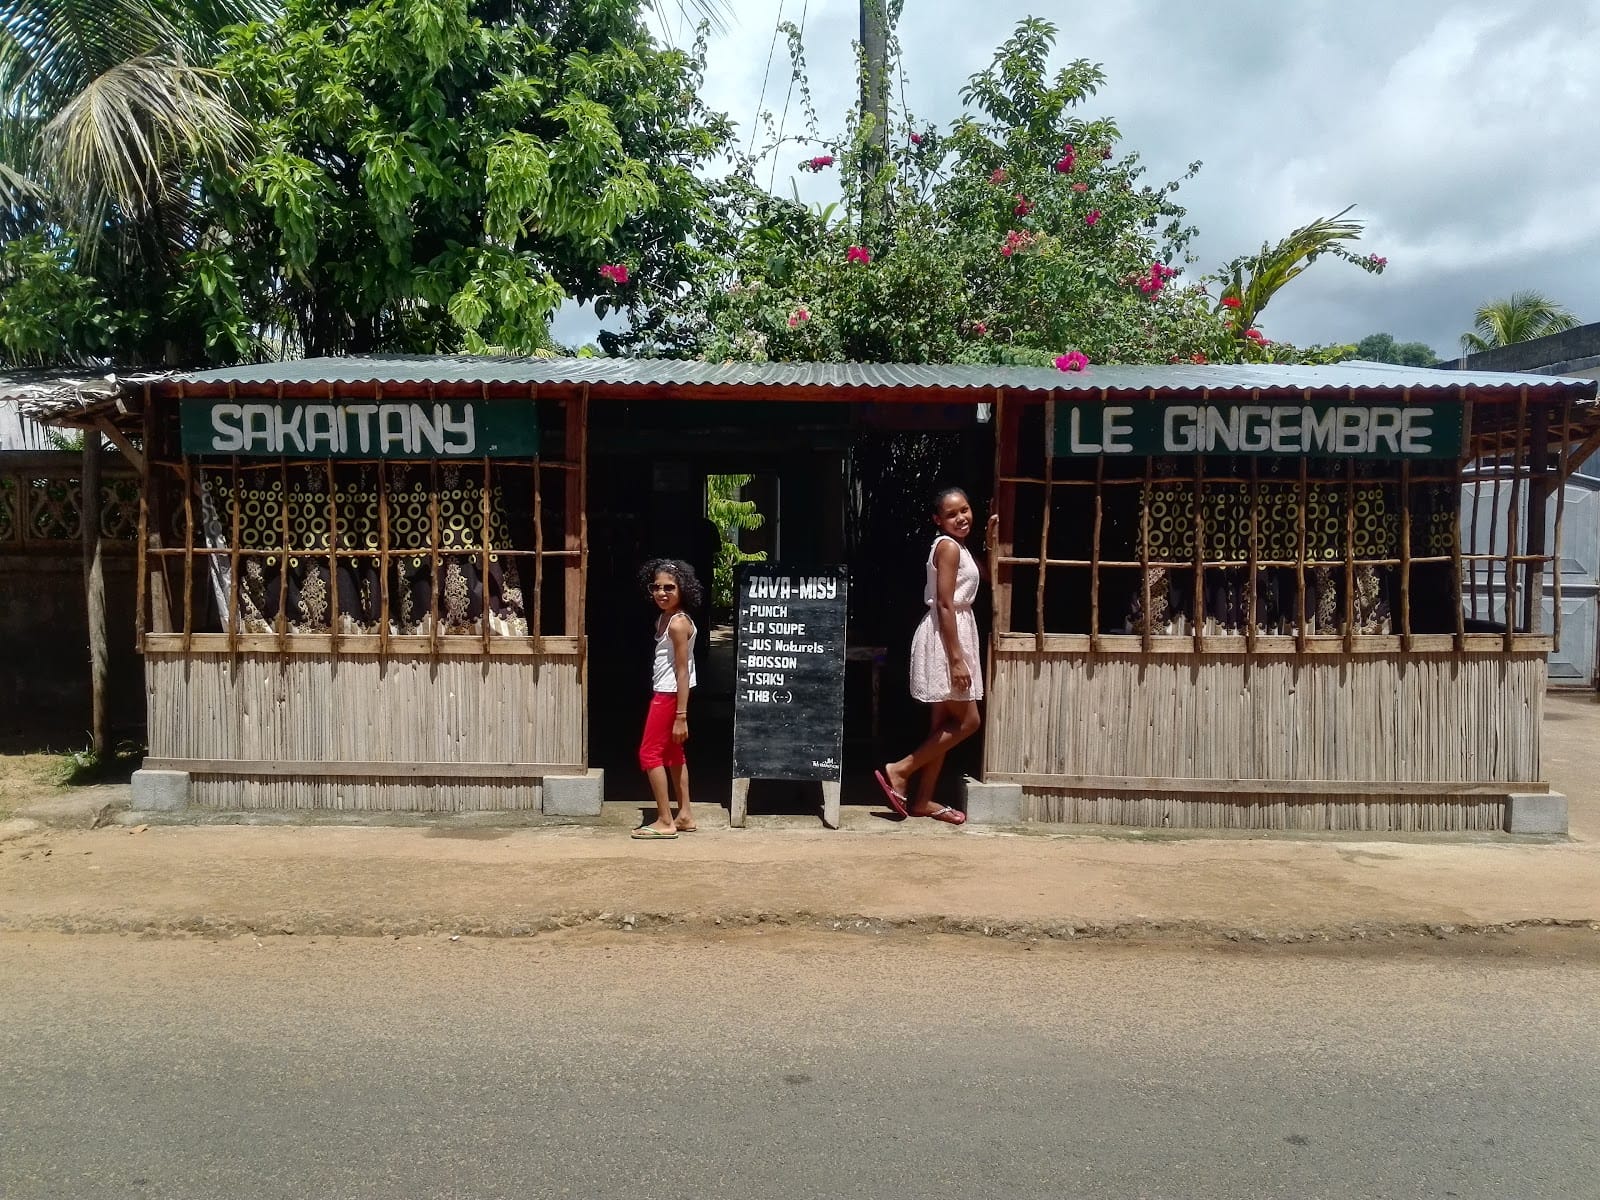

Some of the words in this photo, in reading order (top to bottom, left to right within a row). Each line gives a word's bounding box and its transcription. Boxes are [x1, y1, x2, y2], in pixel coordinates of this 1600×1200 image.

[211, 403, 475, 454] SAKAITANY
[1071, 406, 1134, 453] LE
[1163, 405, 1434, 453] GINGEMBRE
[748, 576, 837, 600] ZAVA-MISY
[768, 623, 806, 636] SOUPE
[775, 640, 824, 653] Naturels
